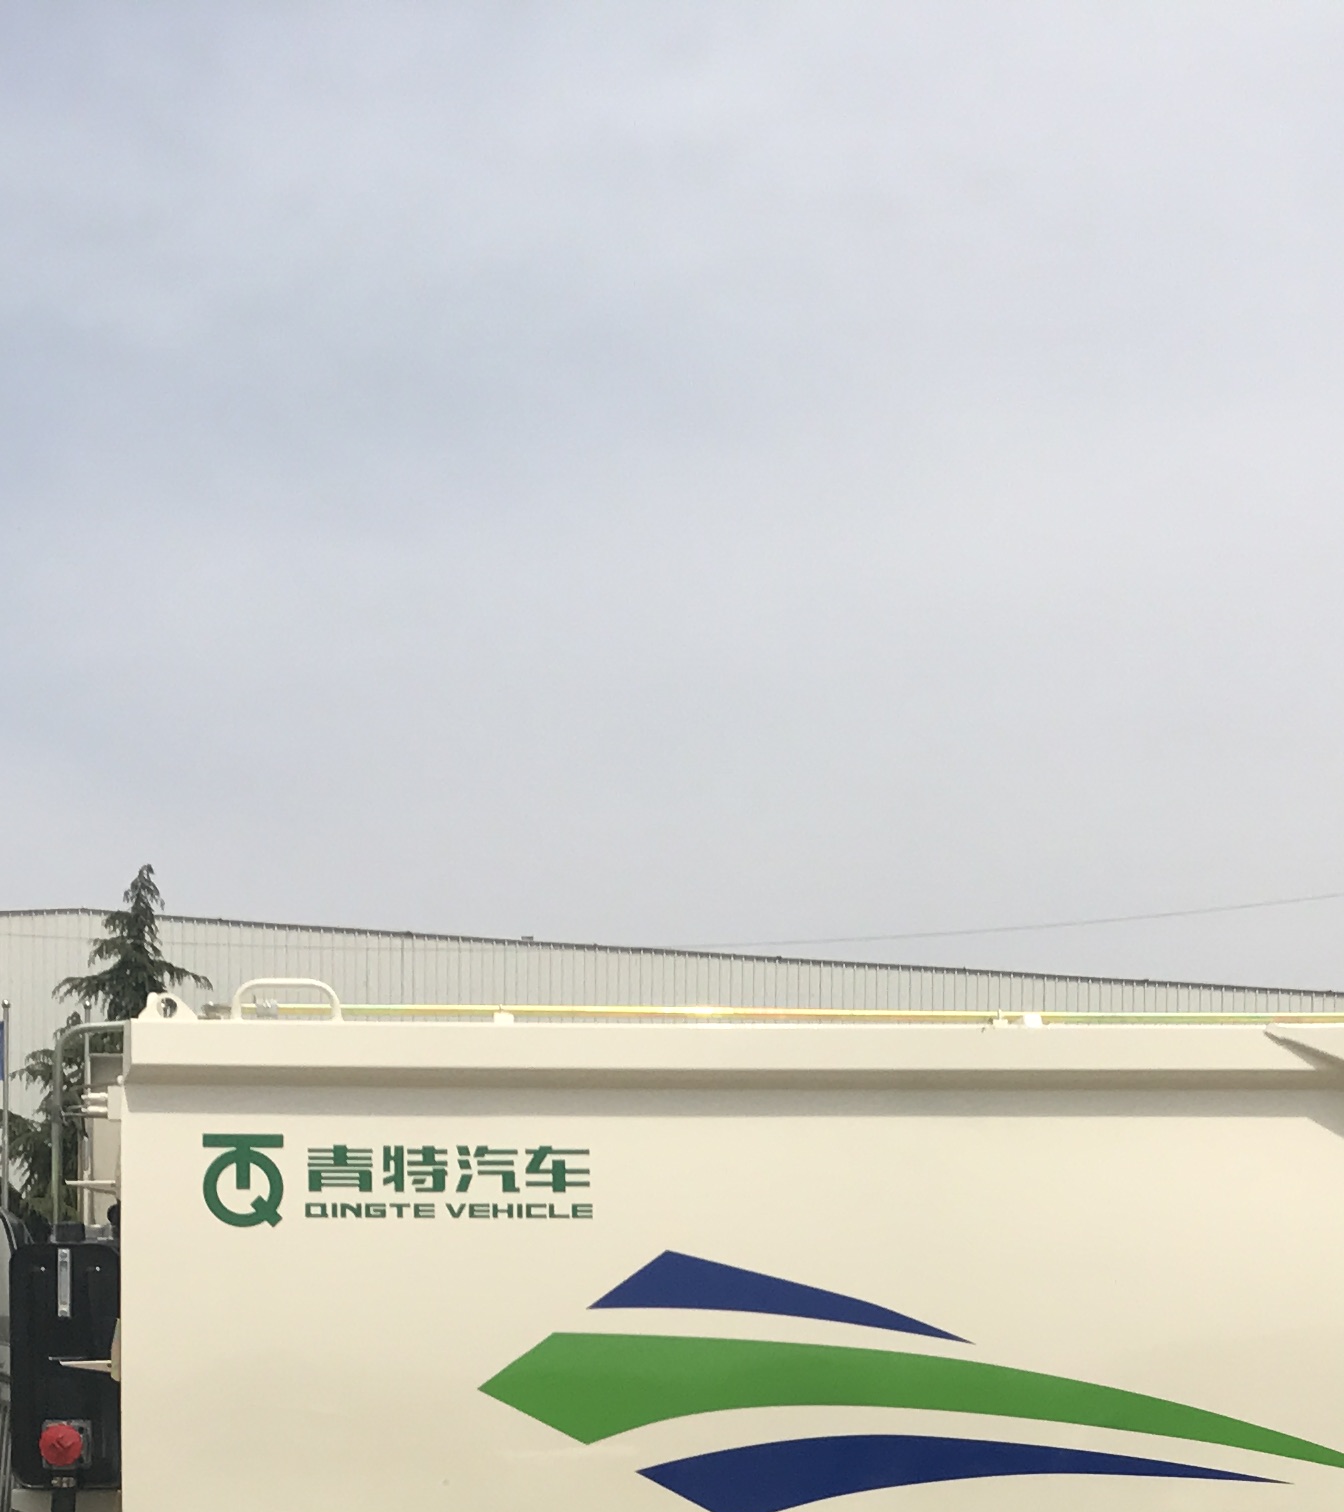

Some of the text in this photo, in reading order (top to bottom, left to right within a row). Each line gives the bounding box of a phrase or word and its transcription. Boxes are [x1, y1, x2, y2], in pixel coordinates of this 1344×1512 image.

[307, 1144, 591, 1193] 青特汽车
[304, 1202, 594, 1219] QINGTE VEHICLE
